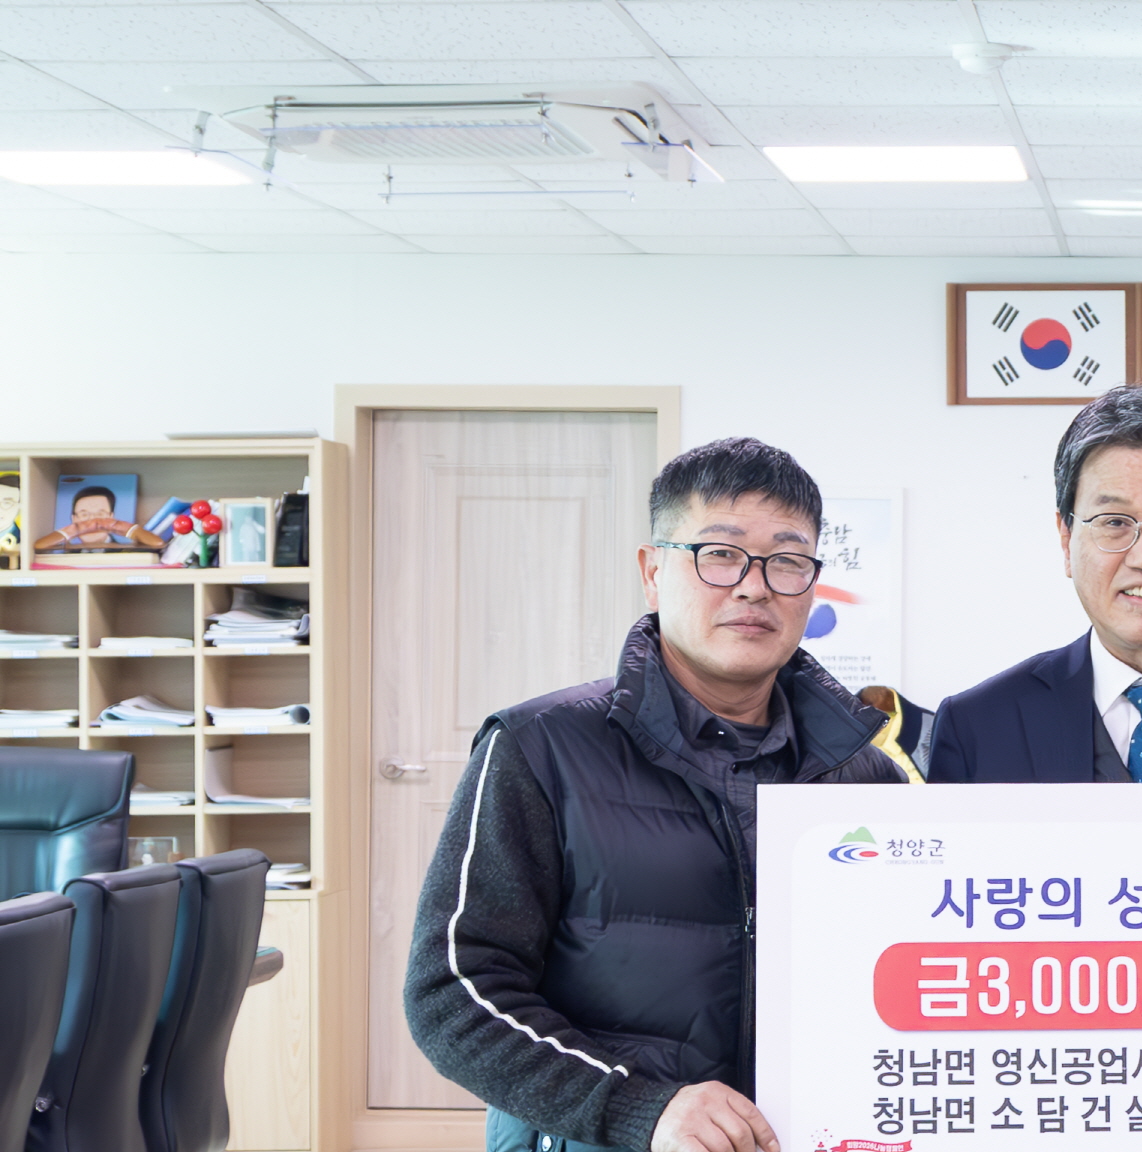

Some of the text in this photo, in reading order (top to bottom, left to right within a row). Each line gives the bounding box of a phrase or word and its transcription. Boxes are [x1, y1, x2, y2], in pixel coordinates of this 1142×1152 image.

[838, 547, 862, 571] 힘
[886, 838, 945, 858] 청양군
[931, 876, 1082, 931] 사랑의
[872, 1047, 975, 1087] 청남면
[872, 1094, 975, 1135] 청남면
